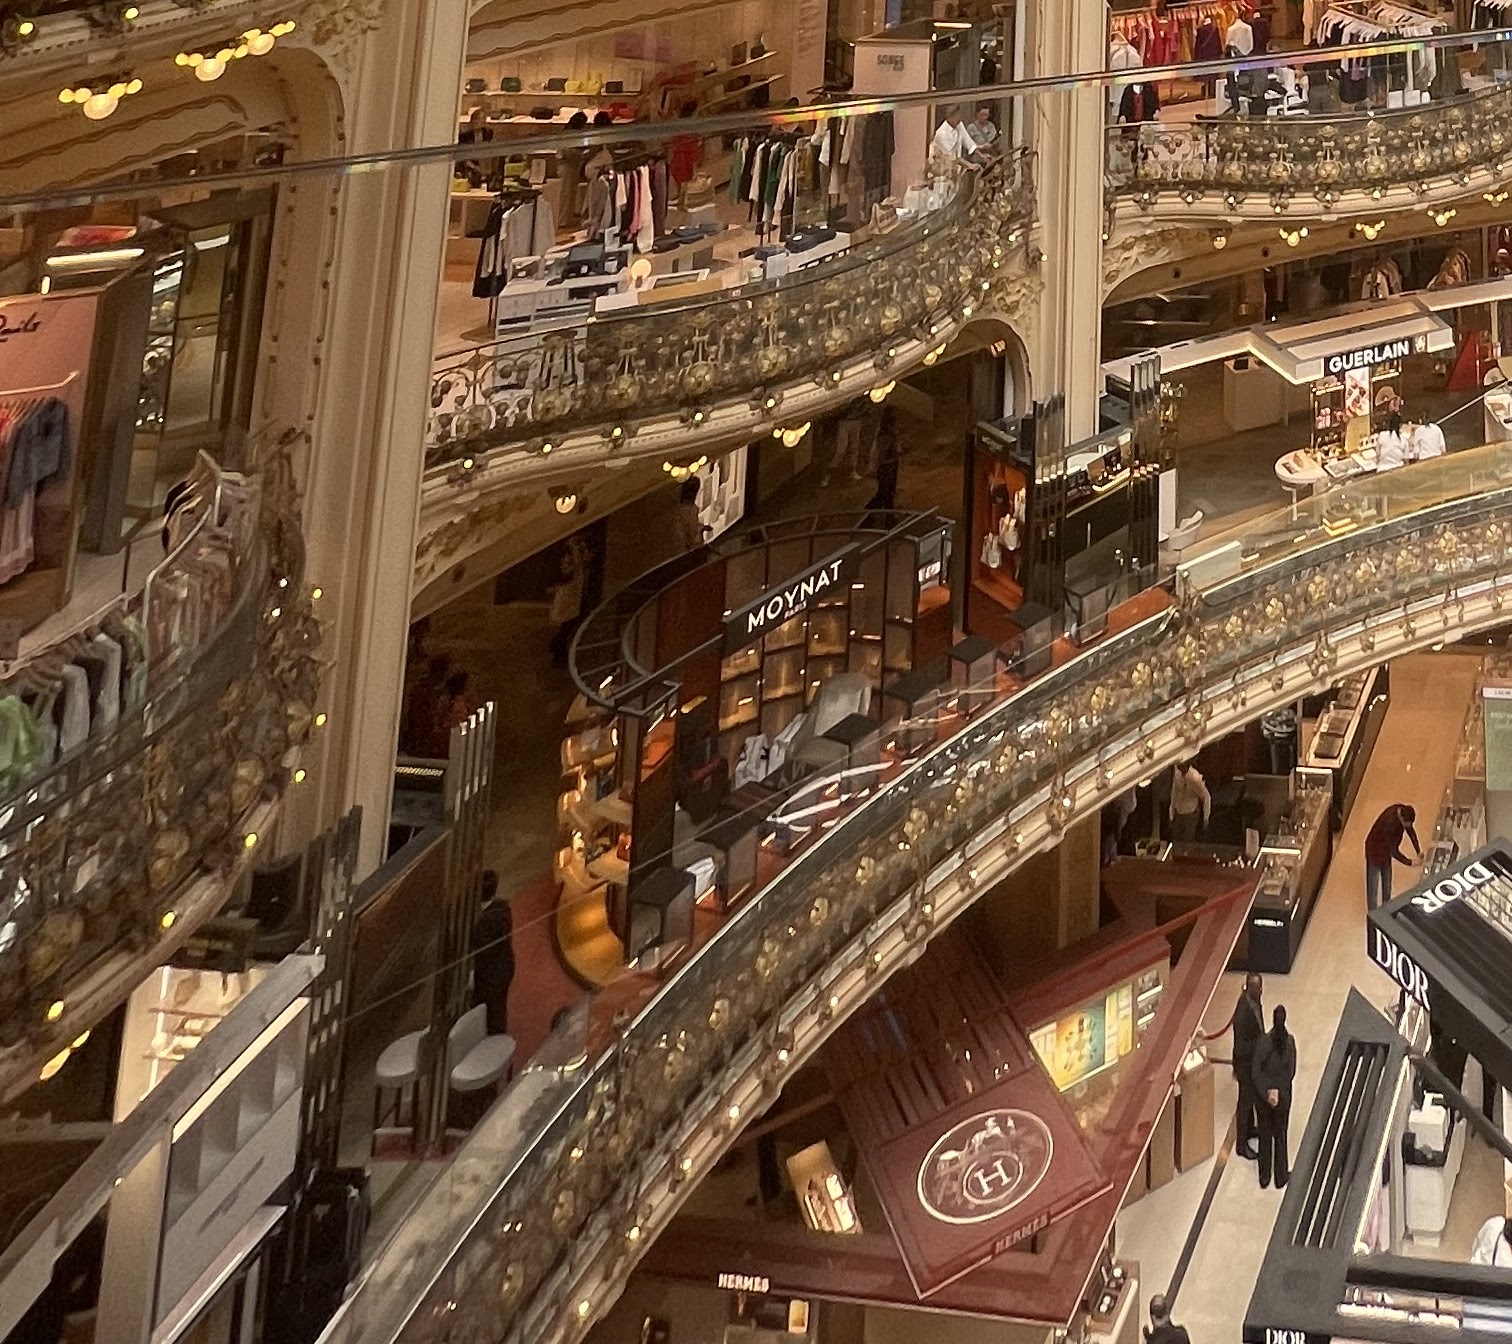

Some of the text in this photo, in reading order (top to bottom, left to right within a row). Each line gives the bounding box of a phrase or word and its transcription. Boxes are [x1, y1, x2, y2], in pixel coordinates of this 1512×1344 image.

[1328, 340, 1410, 374] GUERLAIN
[747, 559, 843, 633] MOYNAT
[1410, 861, 1495, 913] DIOR
[1374, 927, 1432, 1012] DIOR
[973, 1158, 1012, 1197] H
[1265, 1328, 1306, 1344] DIOR
